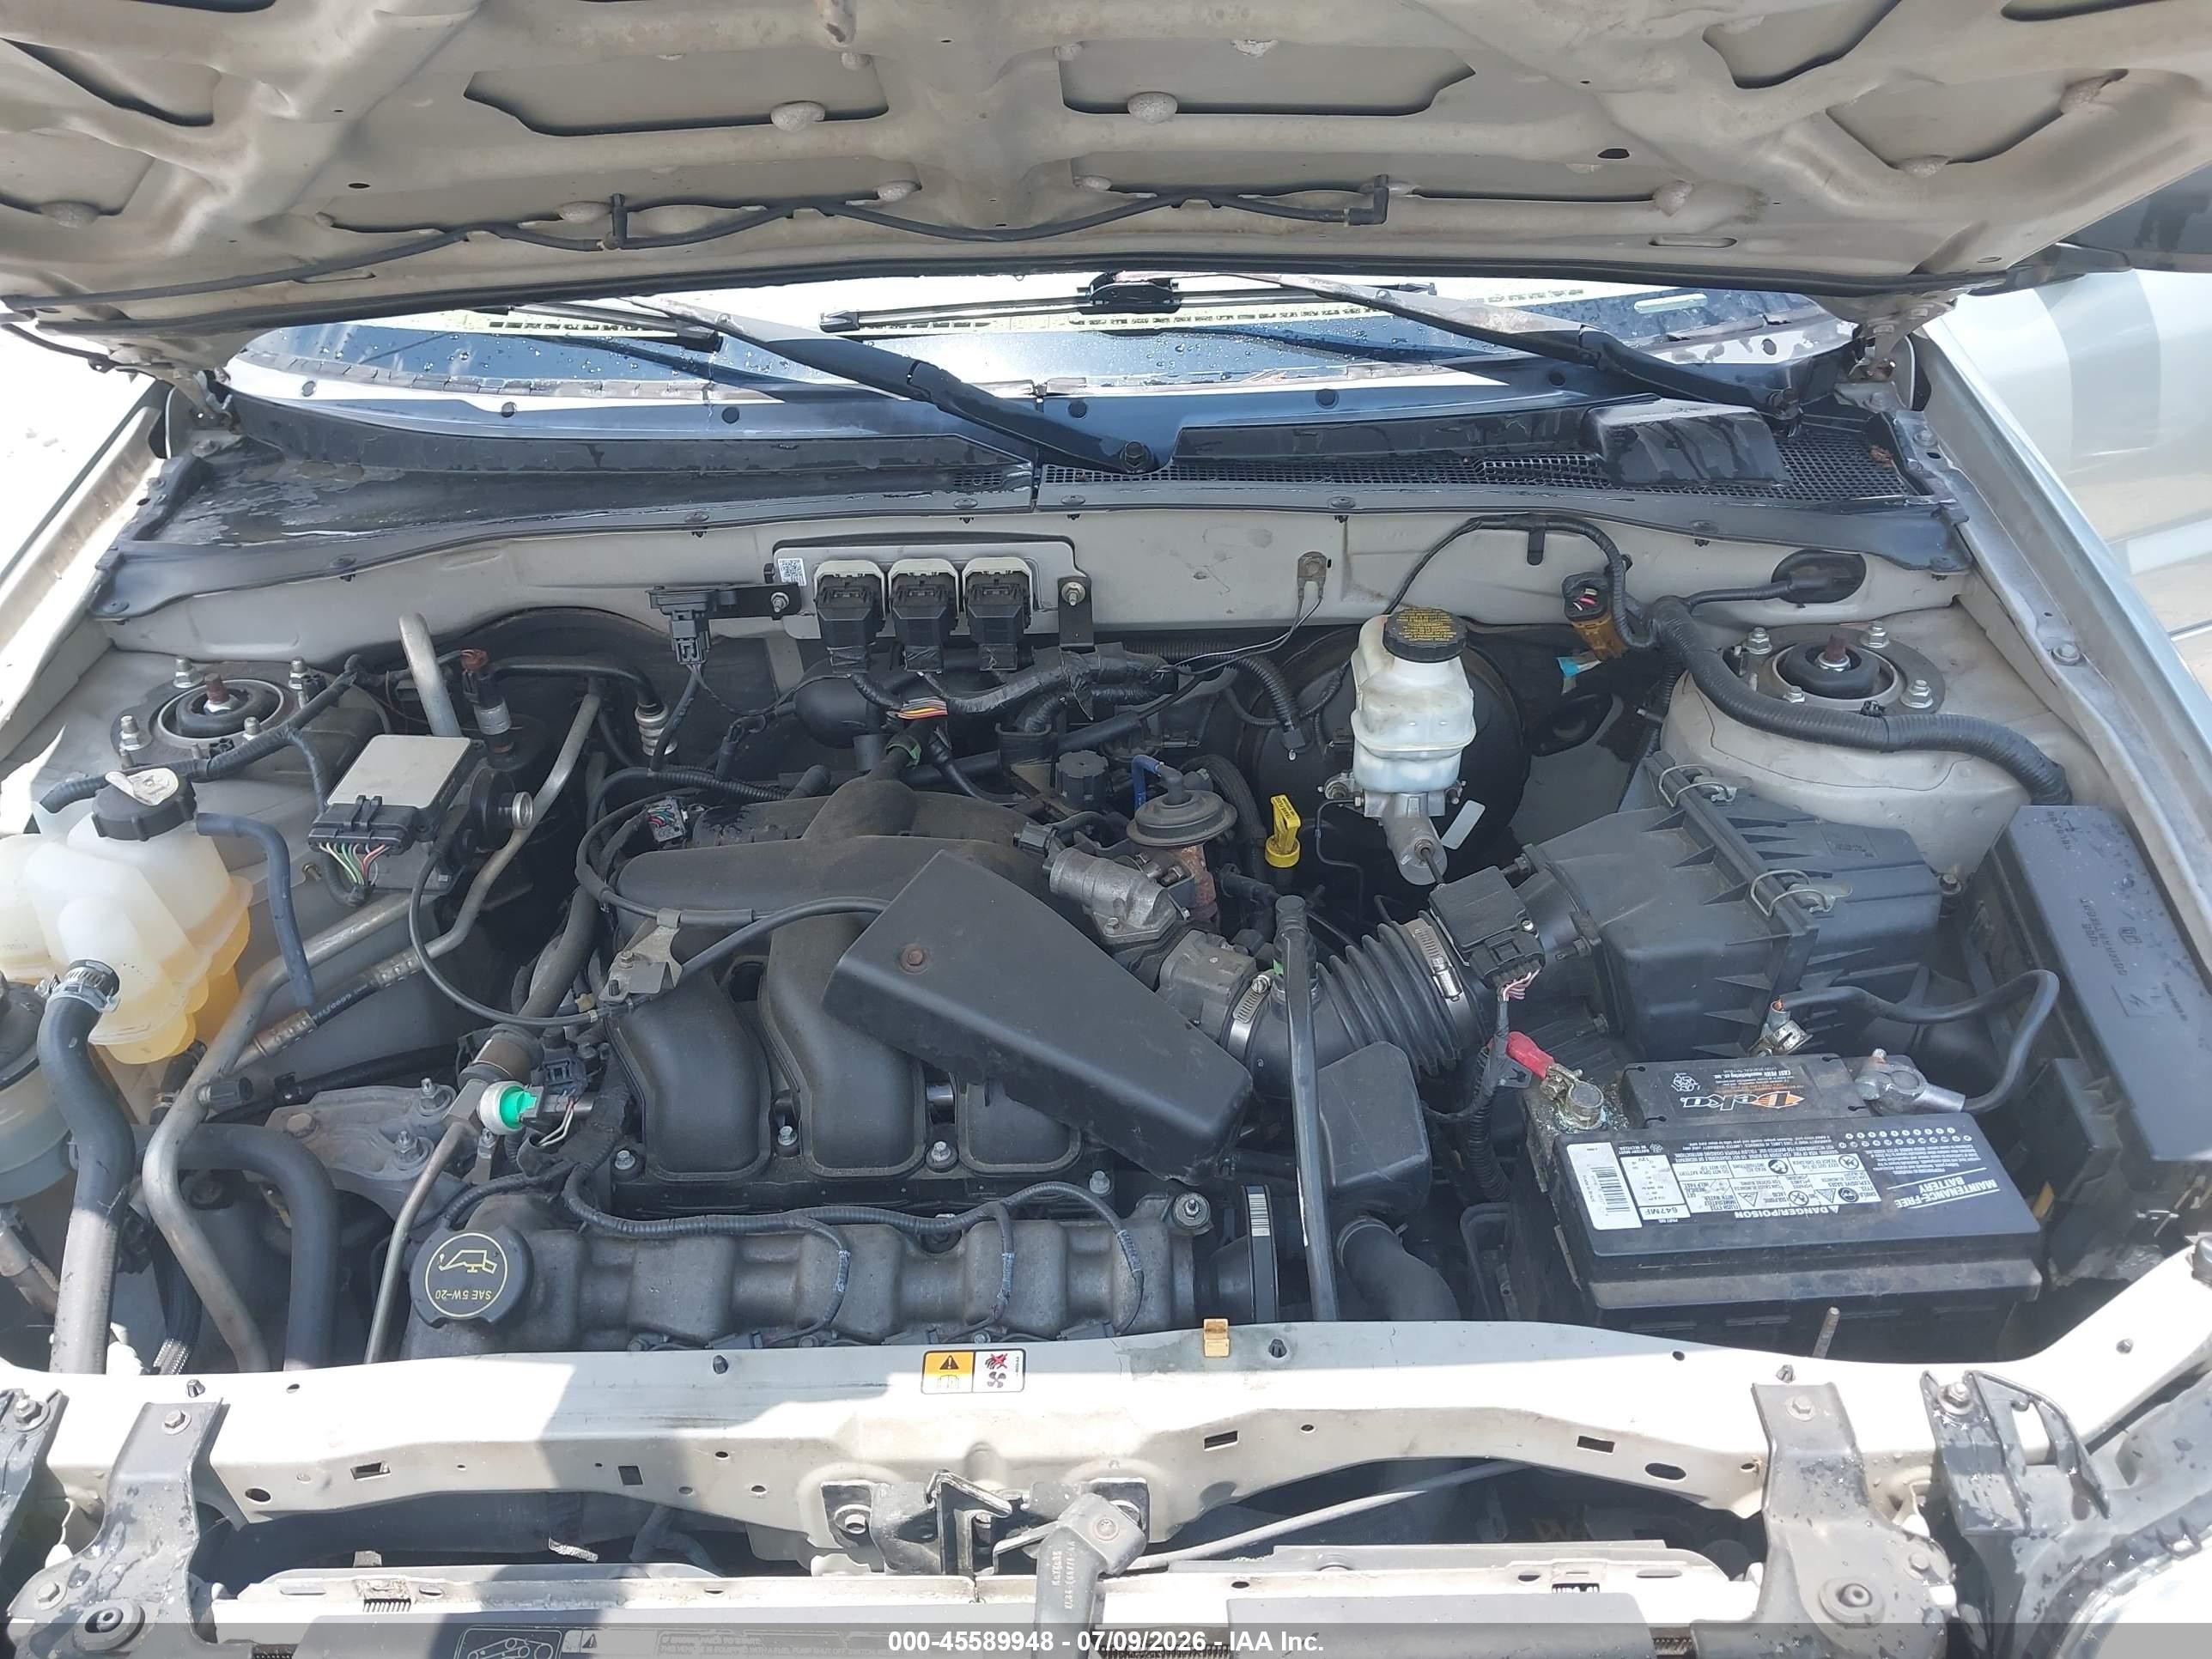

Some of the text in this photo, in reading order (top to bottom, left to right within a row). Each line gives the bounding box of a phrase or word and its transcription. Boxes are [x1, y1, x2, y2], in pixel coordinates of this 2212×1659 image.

[1918, 1177, 1965, 1194] BATTERY
[1894, 1179, 1997, 1207] MAINTENANCE-FREE
[1644, 1206, 1677, 1215] 647MF
[1735, 1206, 1828, 1218] DANGER/POISON
[435, 1290, 492, 1300] SAE 5W-20
